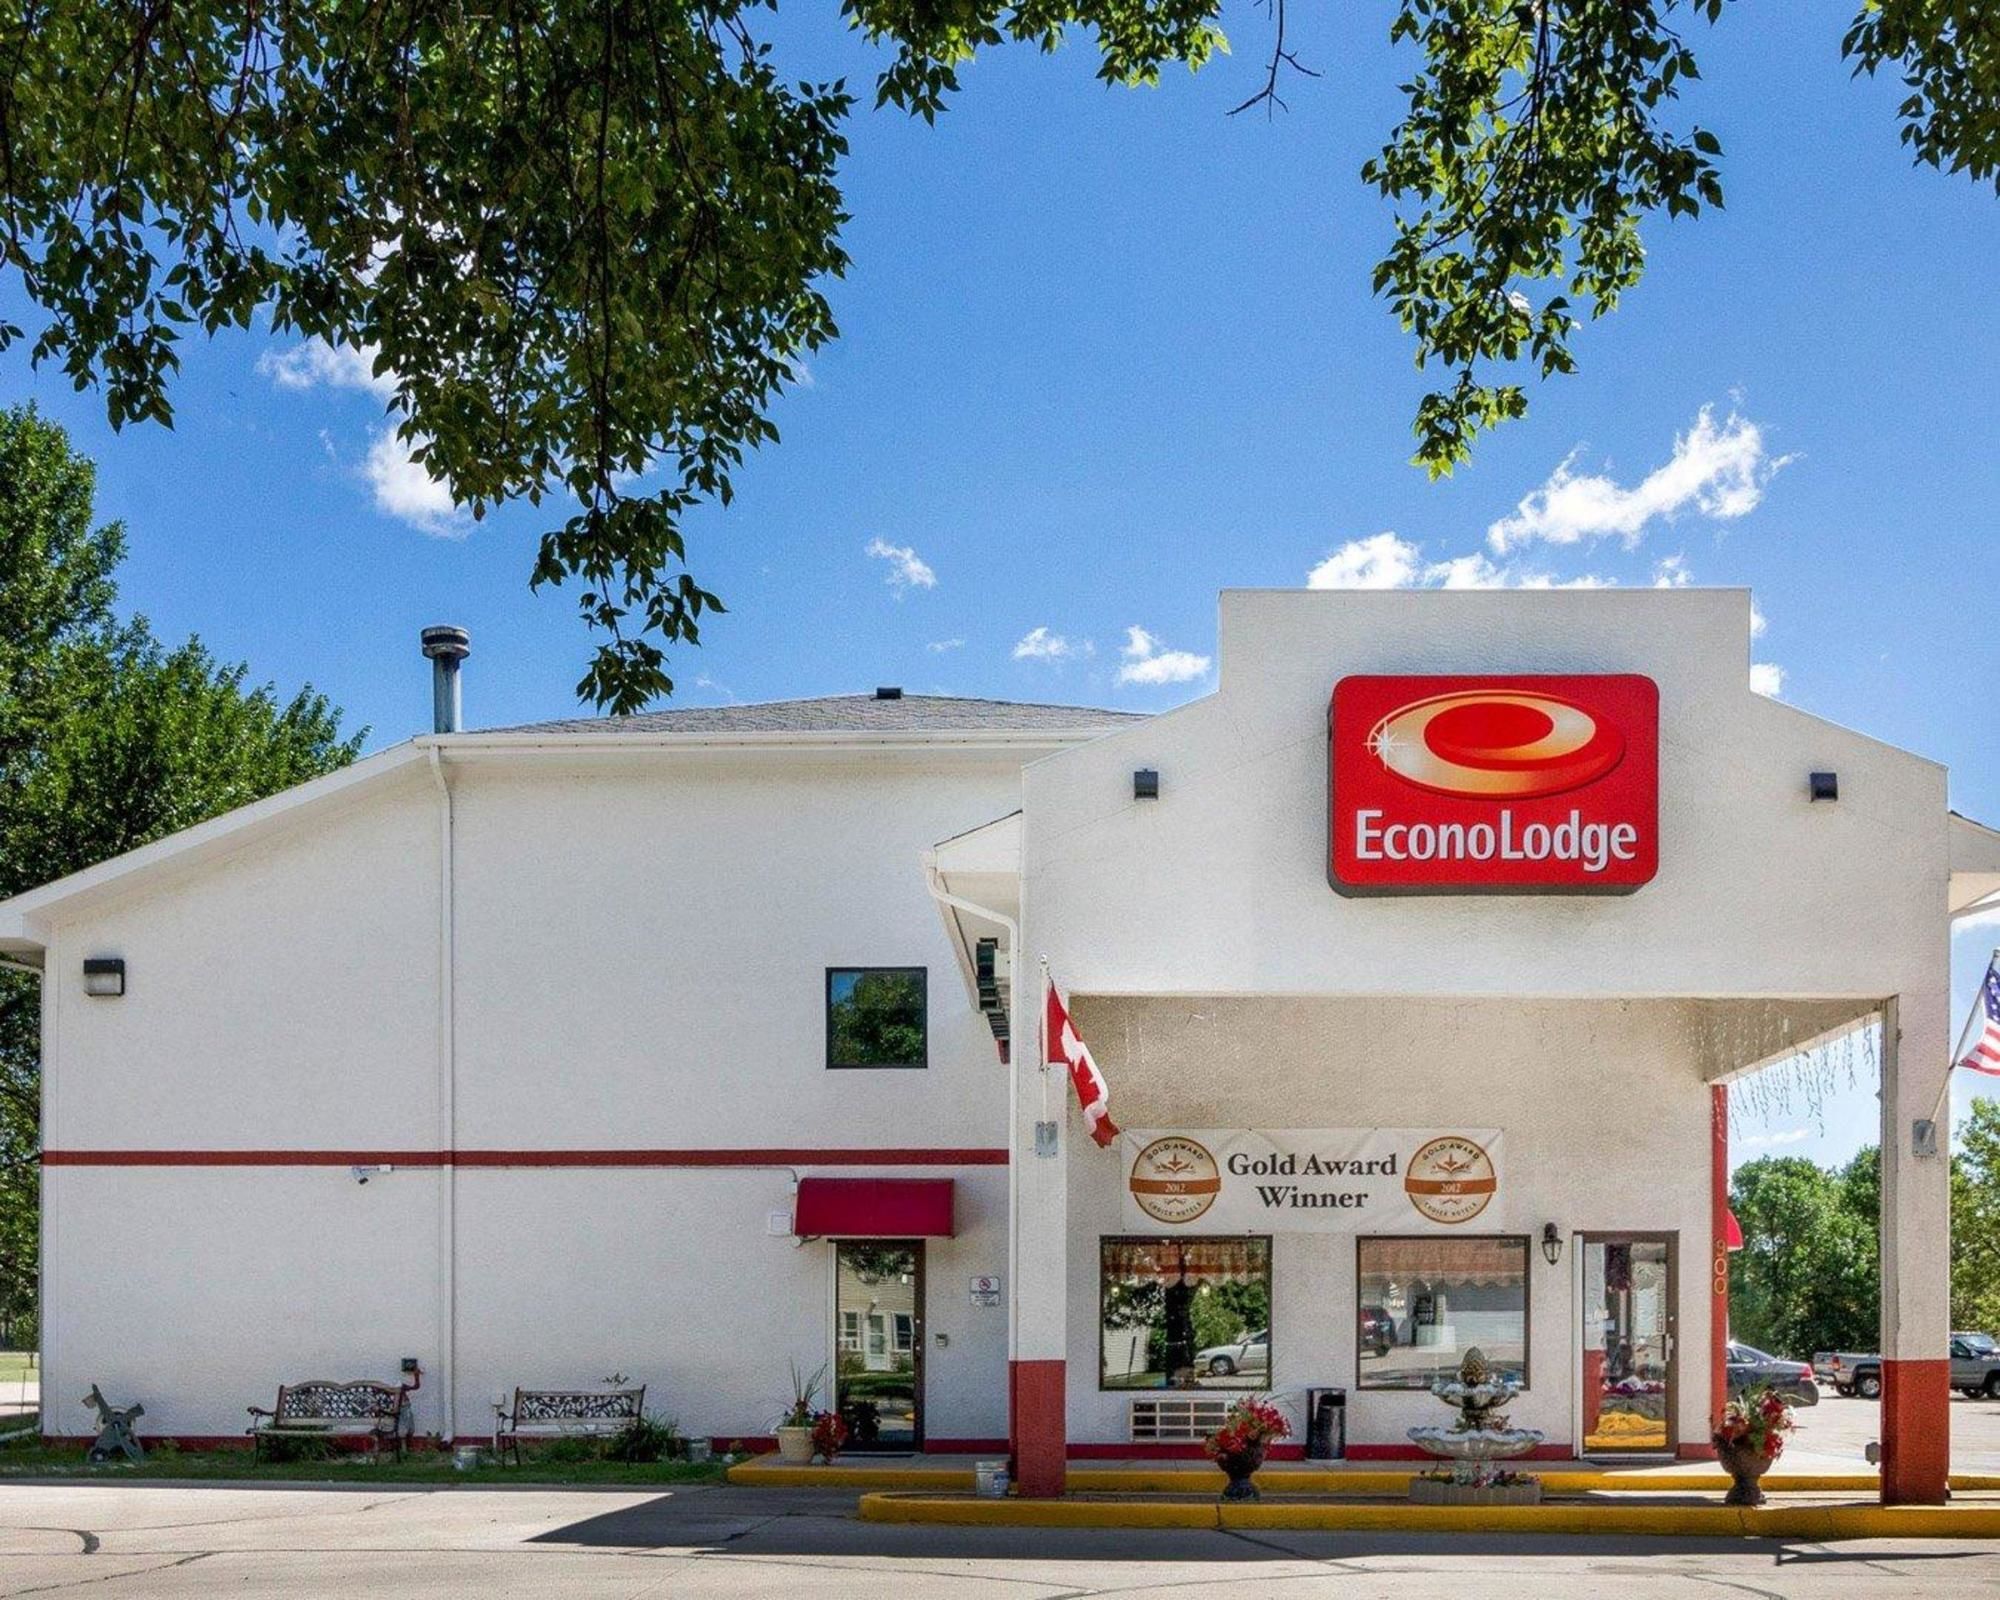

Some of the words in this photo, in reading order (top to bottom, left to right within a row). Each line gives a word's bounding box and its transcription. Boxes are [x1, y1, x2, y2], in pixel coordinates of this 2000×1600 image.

[1146, 1144, 1171, 1160] GOLD
[1172, 1143, 1204, 1160] AWARD
[1422, 1144, 1446, 1160] GOLD
[1448, 1143, 1480, 1160] AWARD
[1227, 1153, 1296, 1176] Gold
[1301, 1153, 1397, 1176] Award
[1255, 1185, 1369, 1208] Winner
